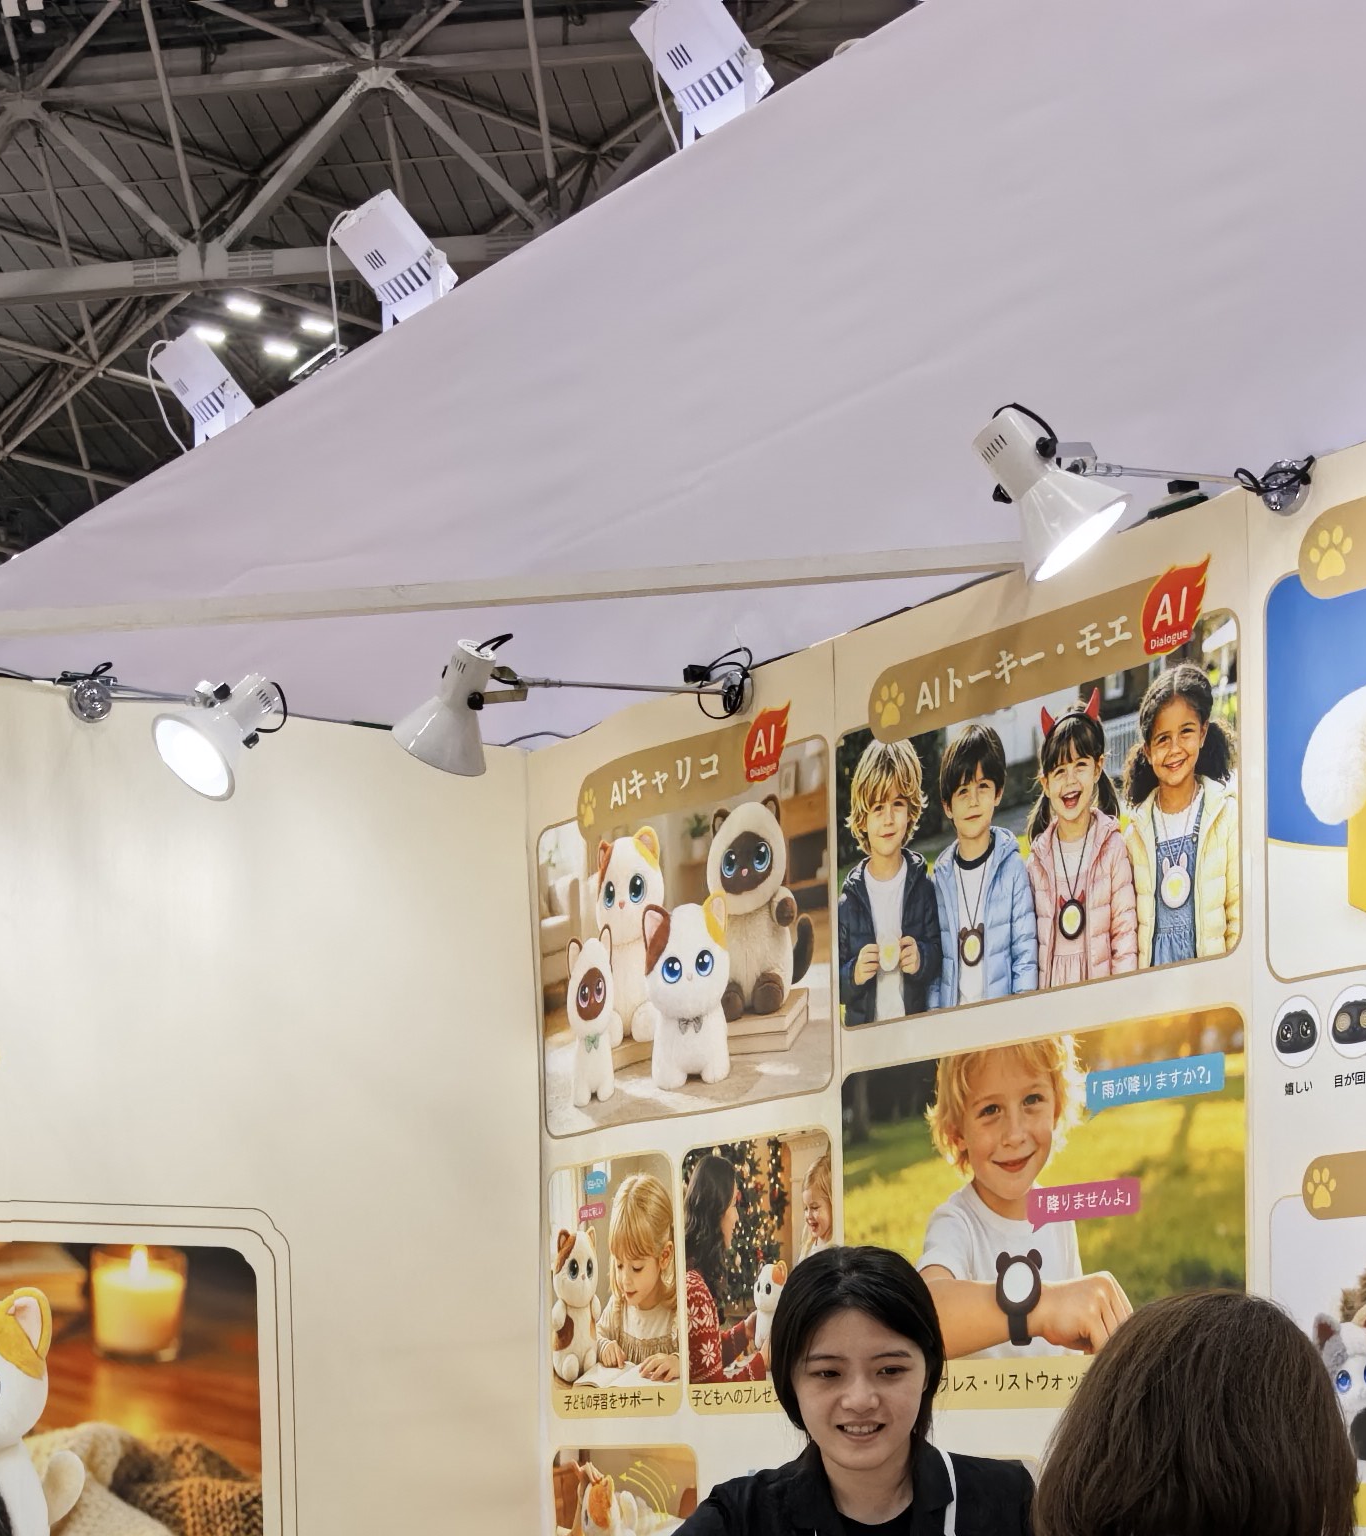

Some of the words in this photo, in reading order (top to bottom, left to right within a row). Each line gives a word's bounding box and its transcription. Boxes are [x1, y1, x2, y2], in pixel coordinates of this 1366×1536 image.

[1152, 586, 1188, 632] AI
[1150, 628, 1188, 650] Dialogue
[751, 723, 776, 761] AI
[691, 1386, 780, 1407] 子どもへのプレゼ
